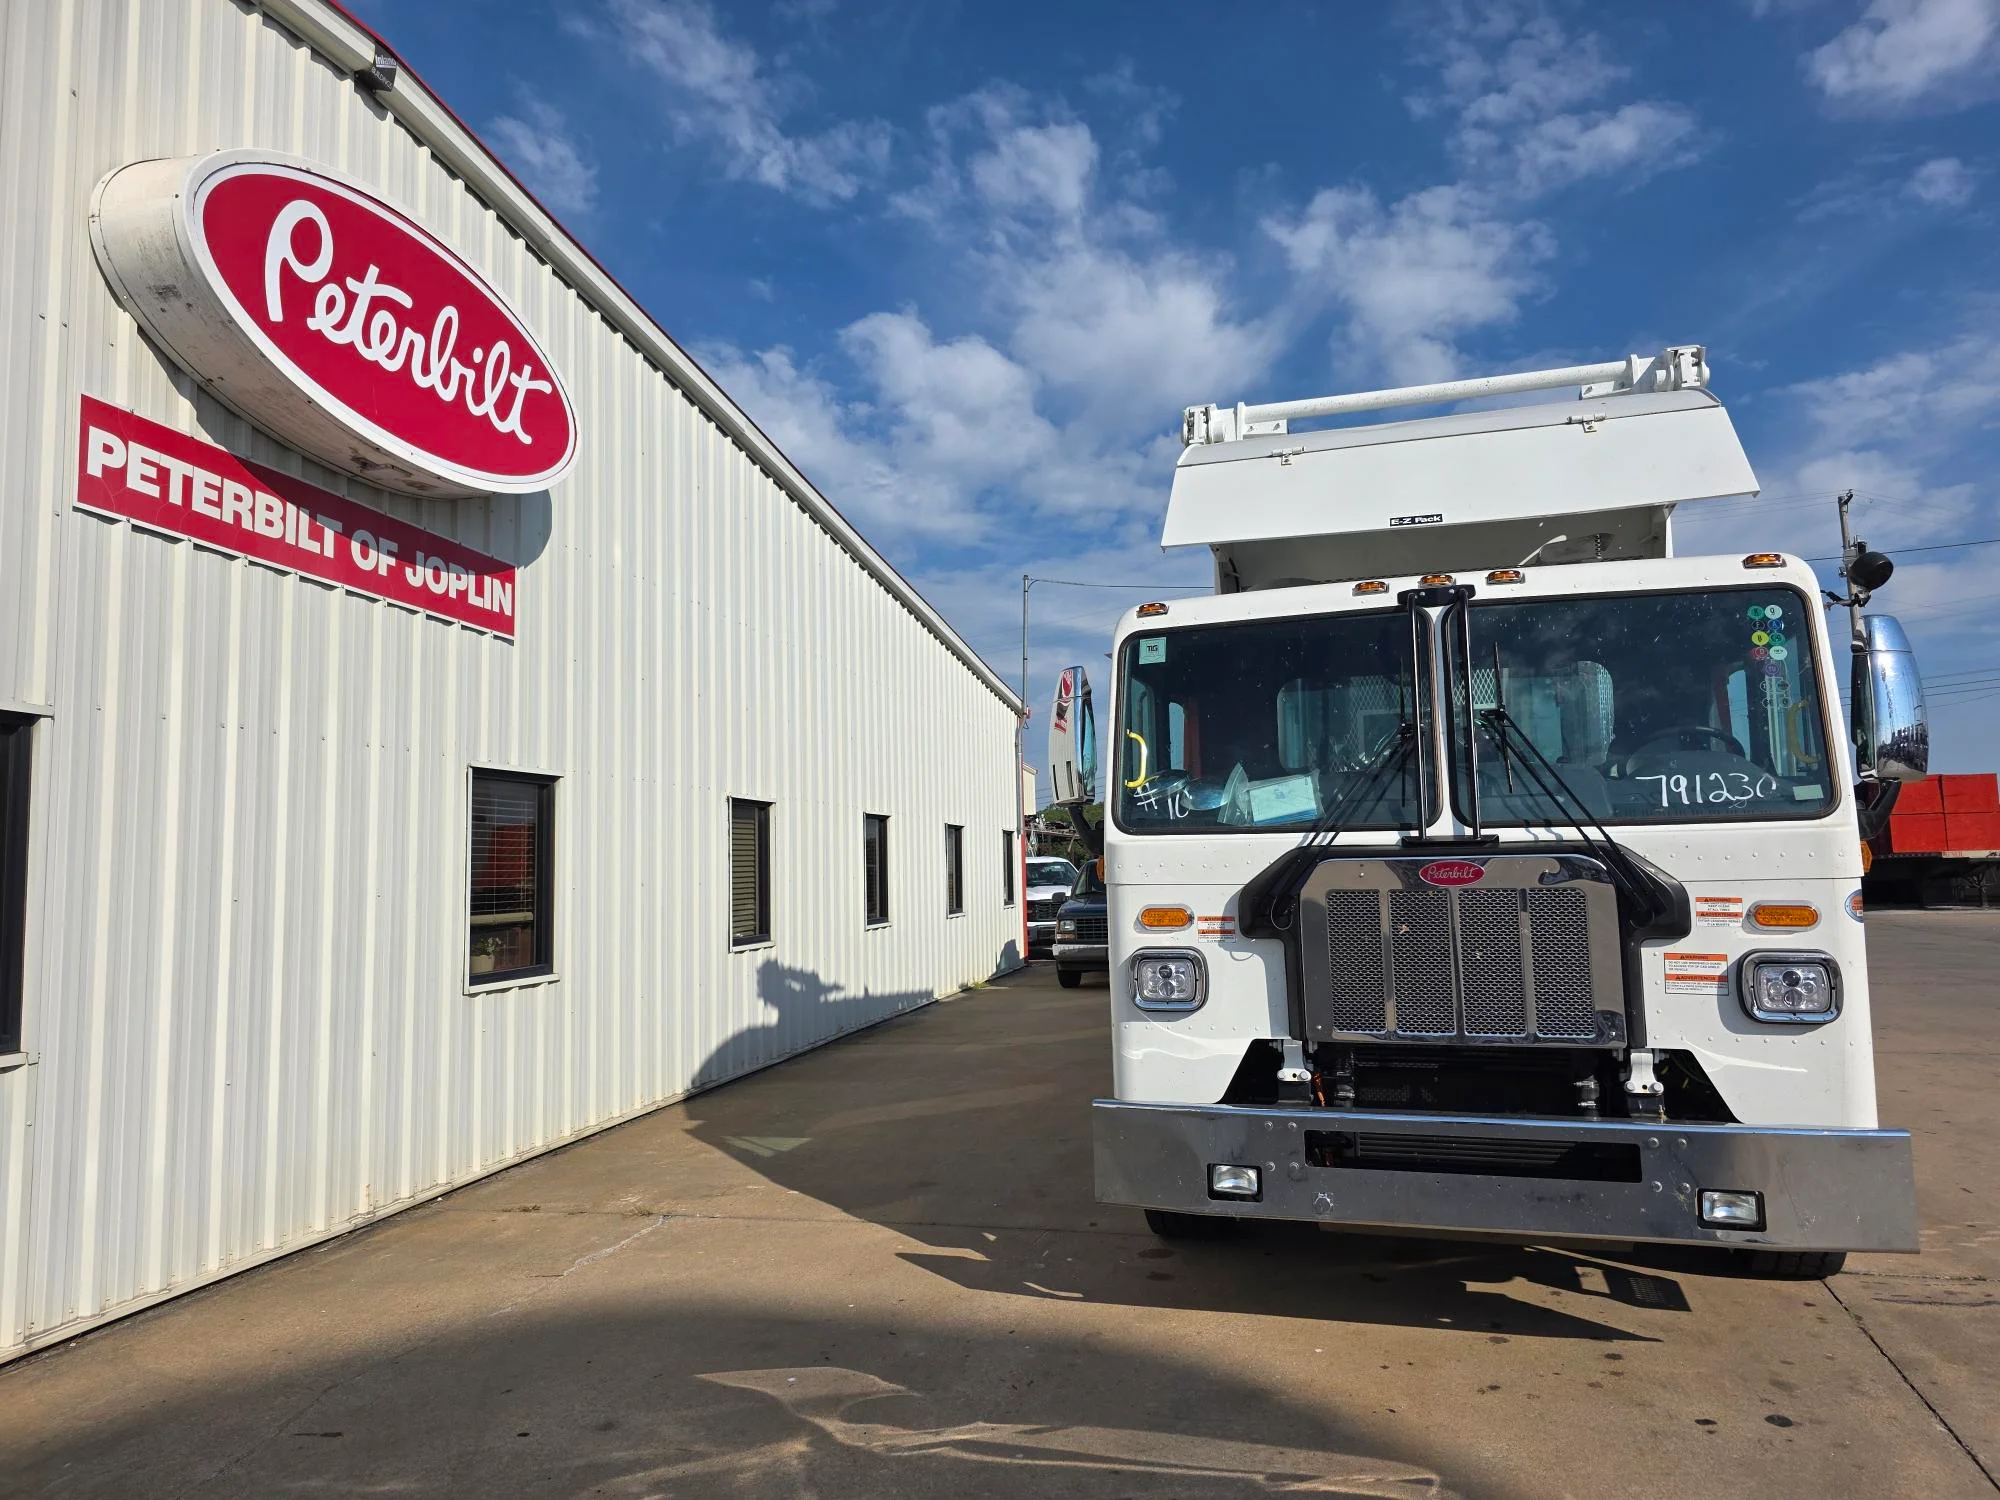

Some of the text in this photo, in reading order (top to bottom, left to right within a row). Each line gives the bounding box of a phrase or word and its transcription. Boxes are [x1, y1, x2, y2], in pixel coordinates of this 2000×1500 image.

[264, 199, 553, 445] Peterbilt
[86, 425, 513, 617] PETERBILT OF JOPLIN
[1390, 515, 1441, 525] E-Z Pack
[1427, 865, 1480, 881] Peterbilt
